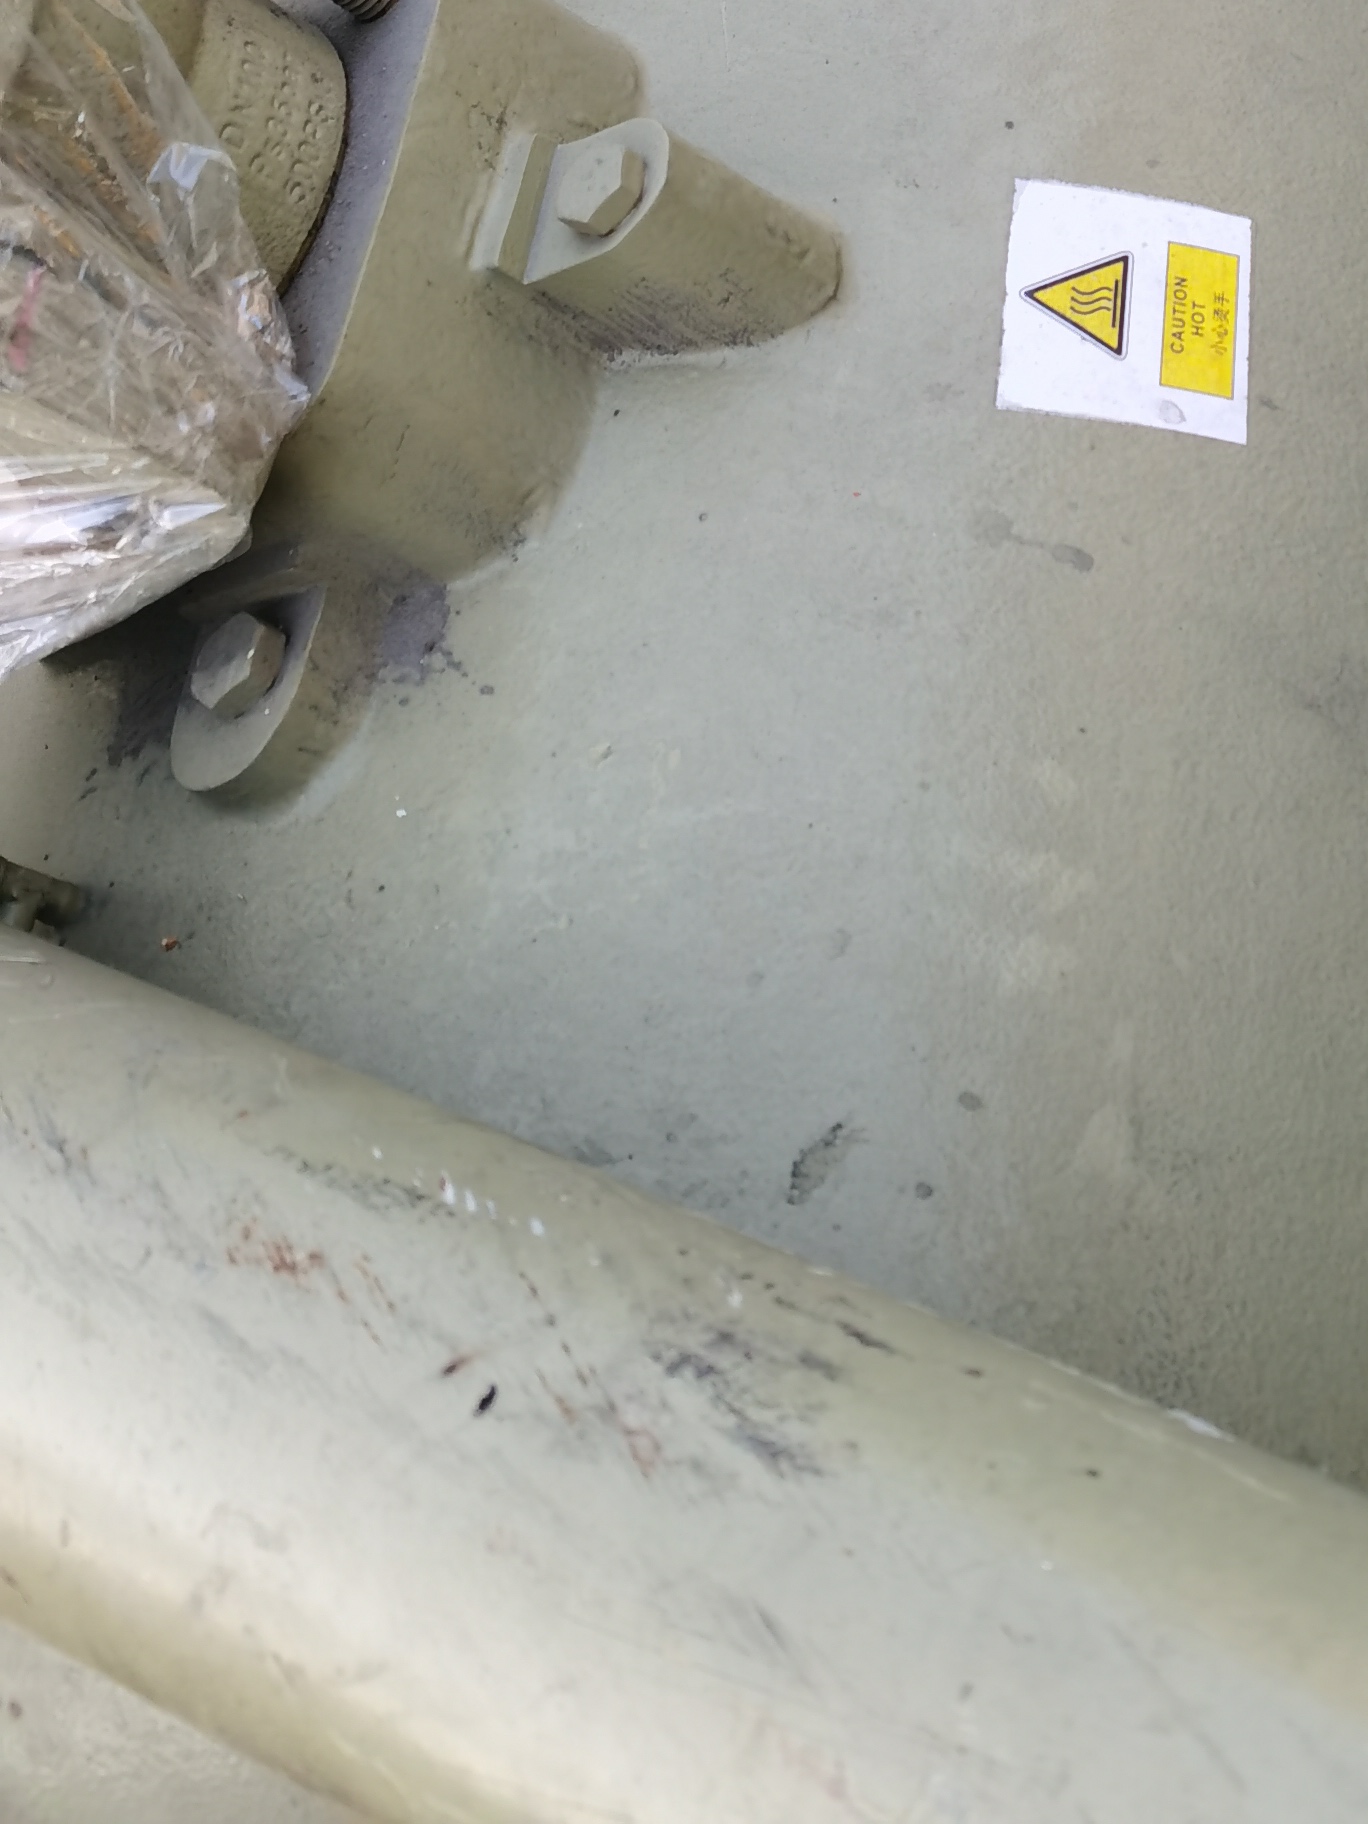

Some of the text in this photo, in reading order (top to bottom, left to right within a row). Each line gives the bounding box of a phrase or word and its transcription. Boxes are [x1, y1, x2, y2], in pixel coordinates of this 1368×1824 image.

[1170, 276, 1189, 354] CAUTION
[1191, 300, 1206, 338] HOT
[1210, 291, 1230, 356] 小心烫手
